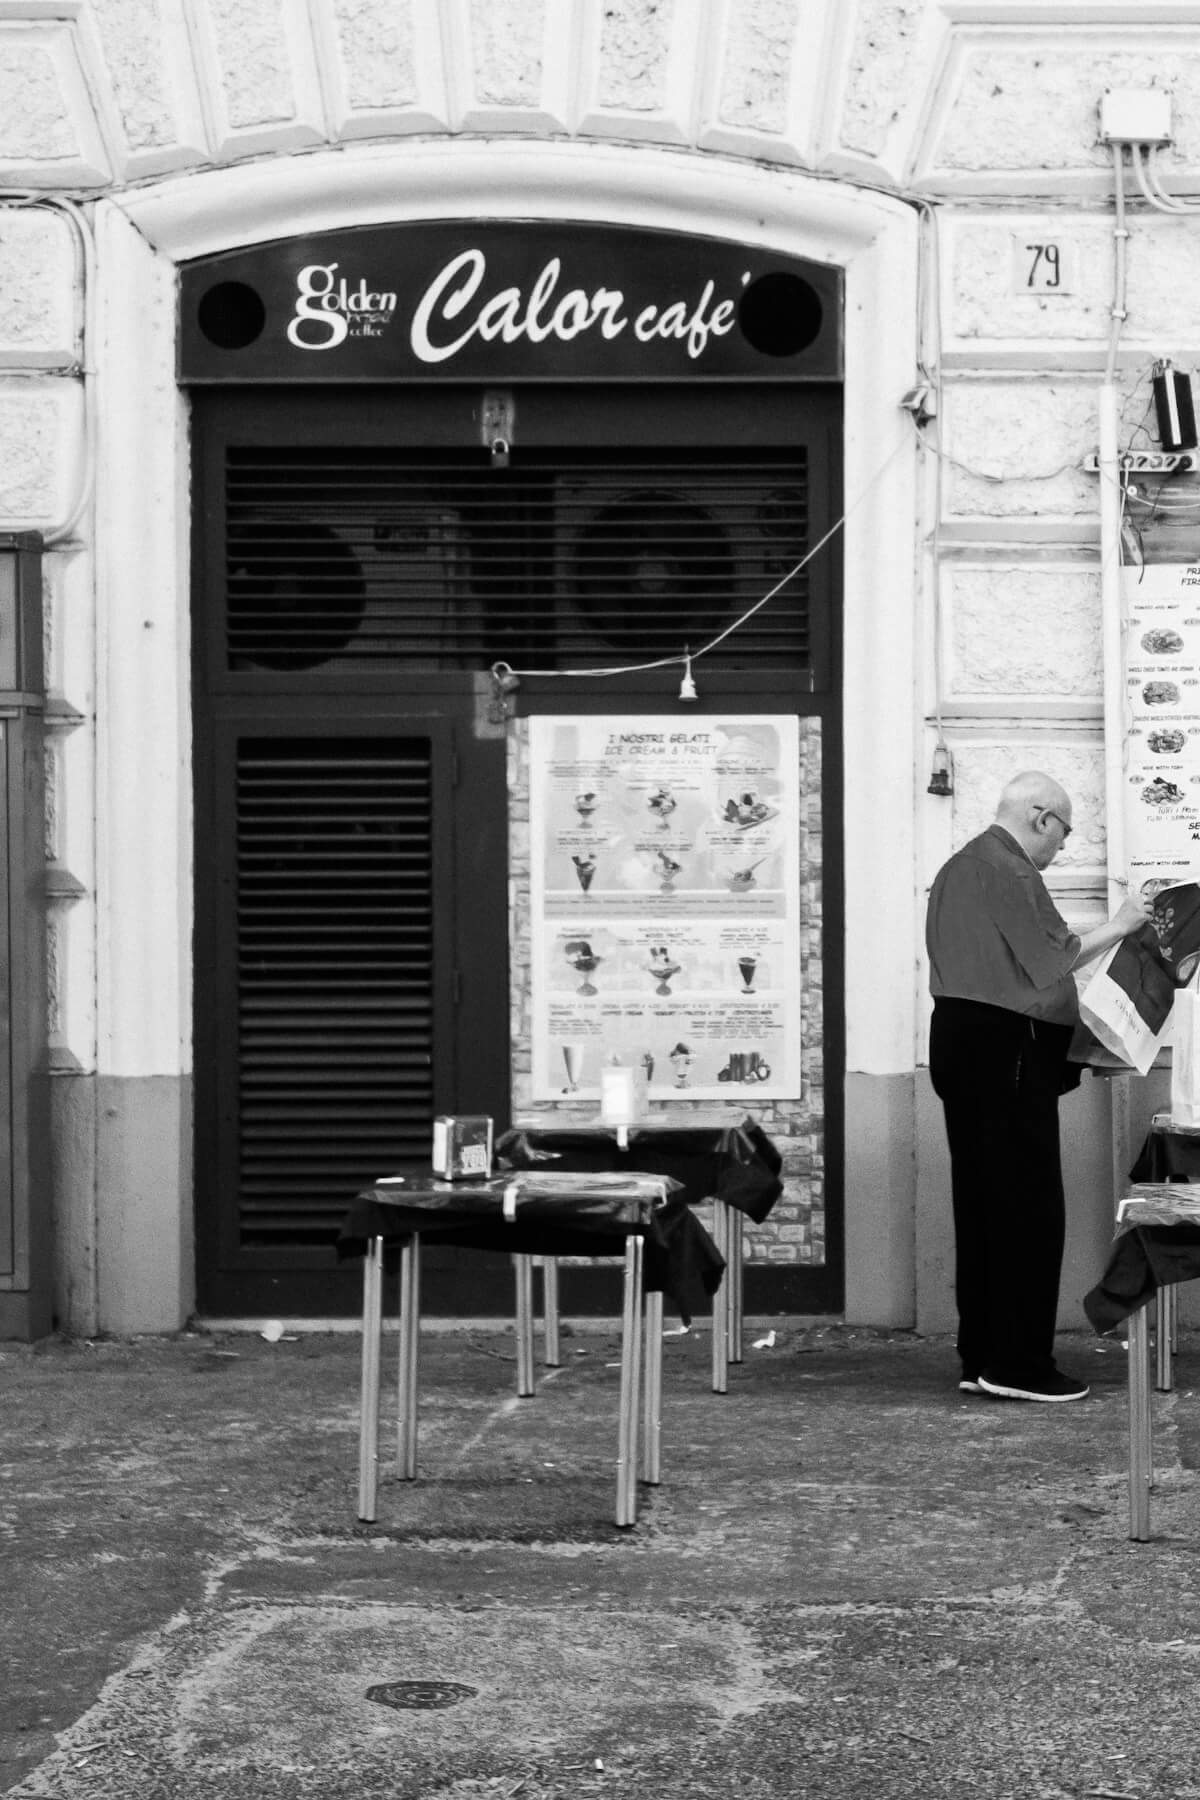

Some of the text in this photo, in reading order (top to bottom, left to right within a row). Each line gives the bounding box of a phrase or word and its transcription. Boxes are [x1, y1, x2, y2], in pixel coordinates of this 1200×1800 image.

[1026, 244, 1060, 288] 79
[286, 262, 398, 351] golden
[410, 248, 628, 363] Calor
[604, 746, 624, 755] ICE
[628, 746, 666, 755] CREAM
[683, 745, 718, 755] FRUIT
[608, 733, 711, 743] I NOSTRI GELATI
